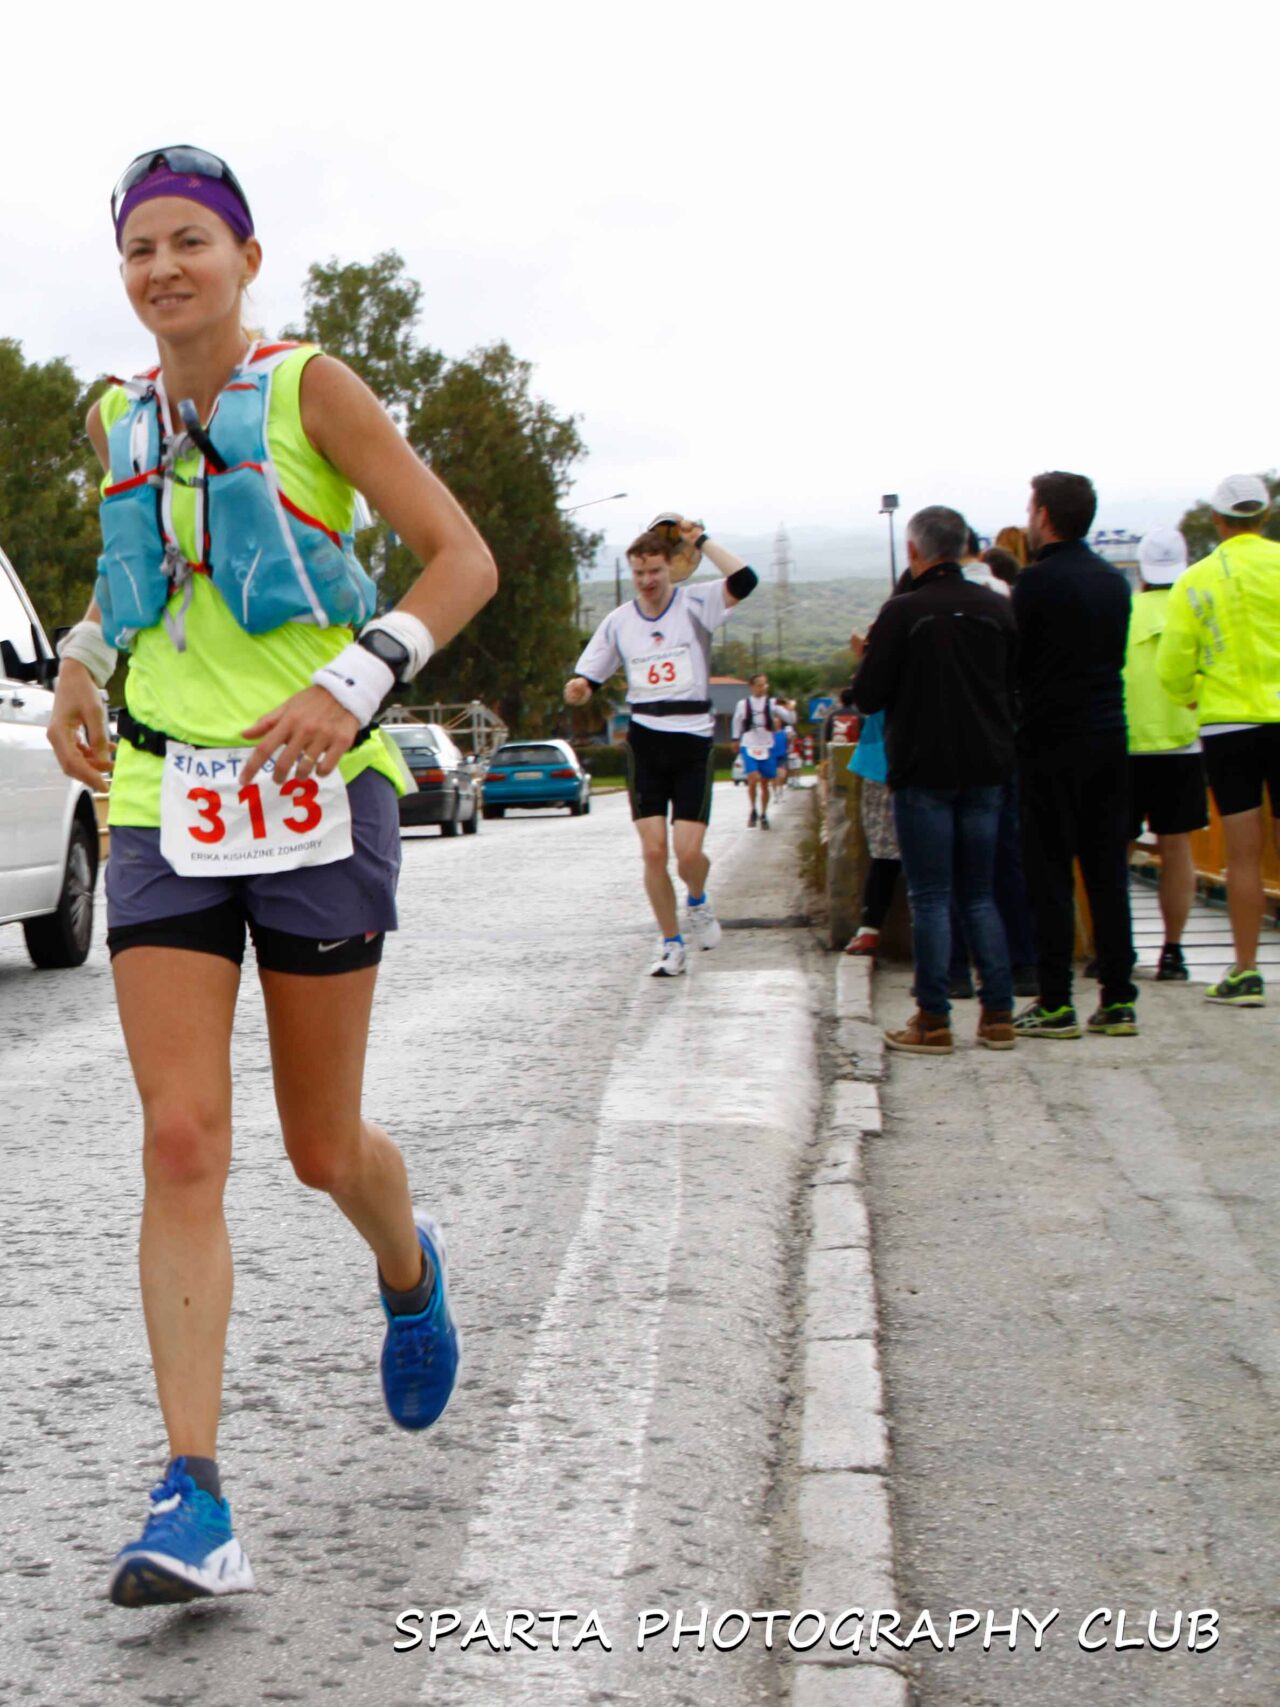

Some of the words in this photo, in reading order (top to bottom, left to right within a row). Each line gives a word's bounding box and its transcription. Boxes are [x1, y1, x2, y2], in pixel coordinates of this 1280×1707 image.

[647, 661, 677, 685] 63
[187, 777, 323, 844] 313
[190, 852, 220, 862] ERIKA
[277, 839, 323, 856] ZOMBORY
